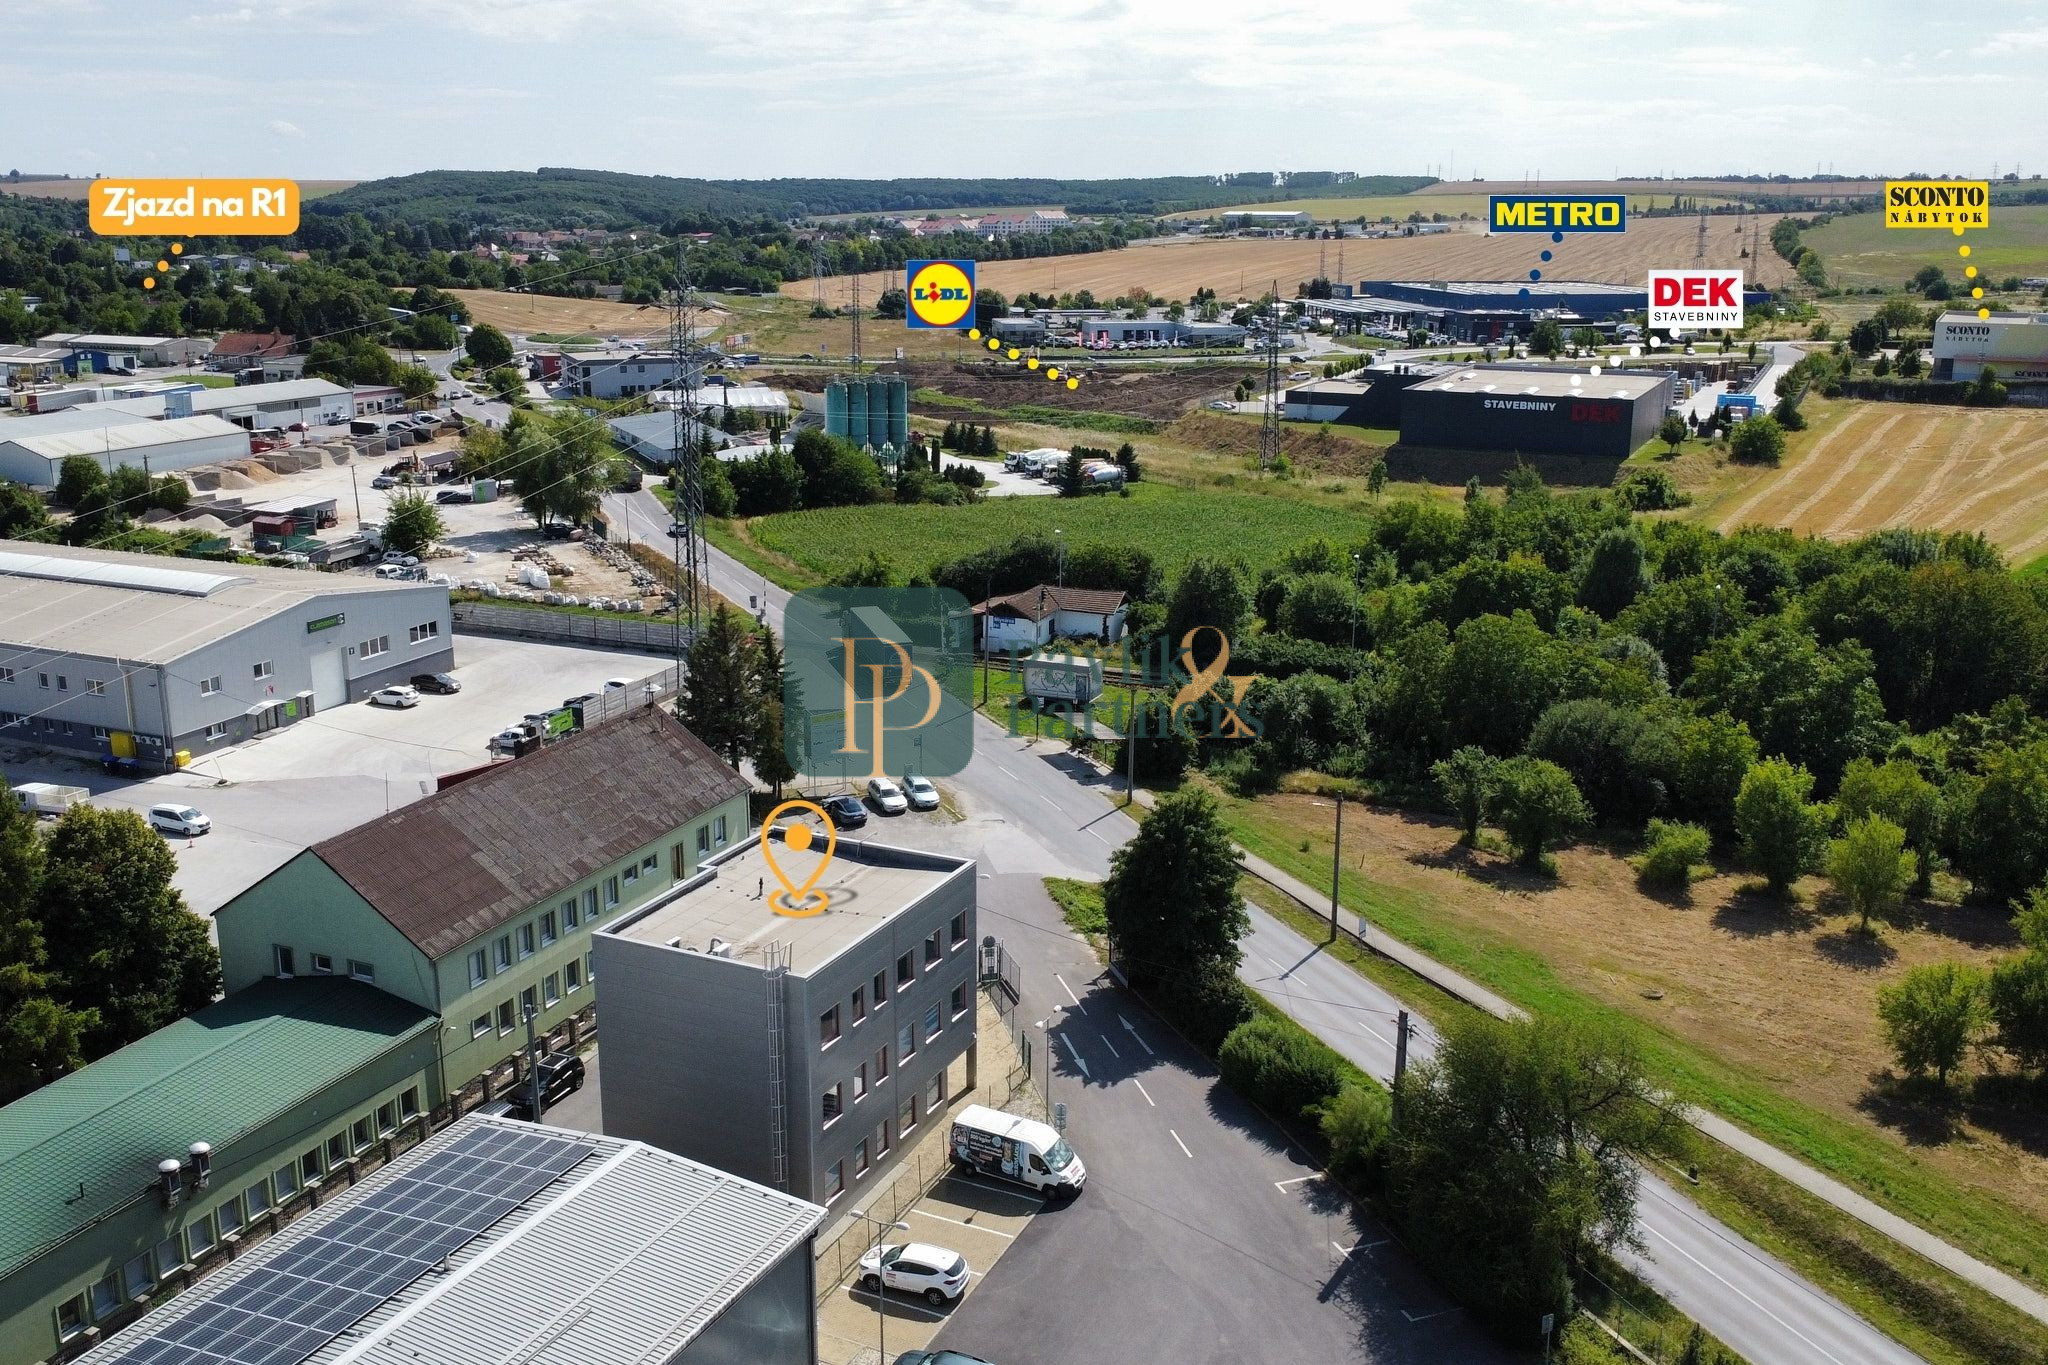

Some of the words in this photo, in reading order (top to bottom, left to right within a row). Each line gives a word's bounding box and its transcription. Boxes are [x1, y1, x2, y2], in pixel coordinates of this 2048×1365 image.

[1946, 326, 1990, 336] SCONTO
[1483, 399, 1556, 411] STAVEBNINY
[1571, 404, 1621, 422] DEK
